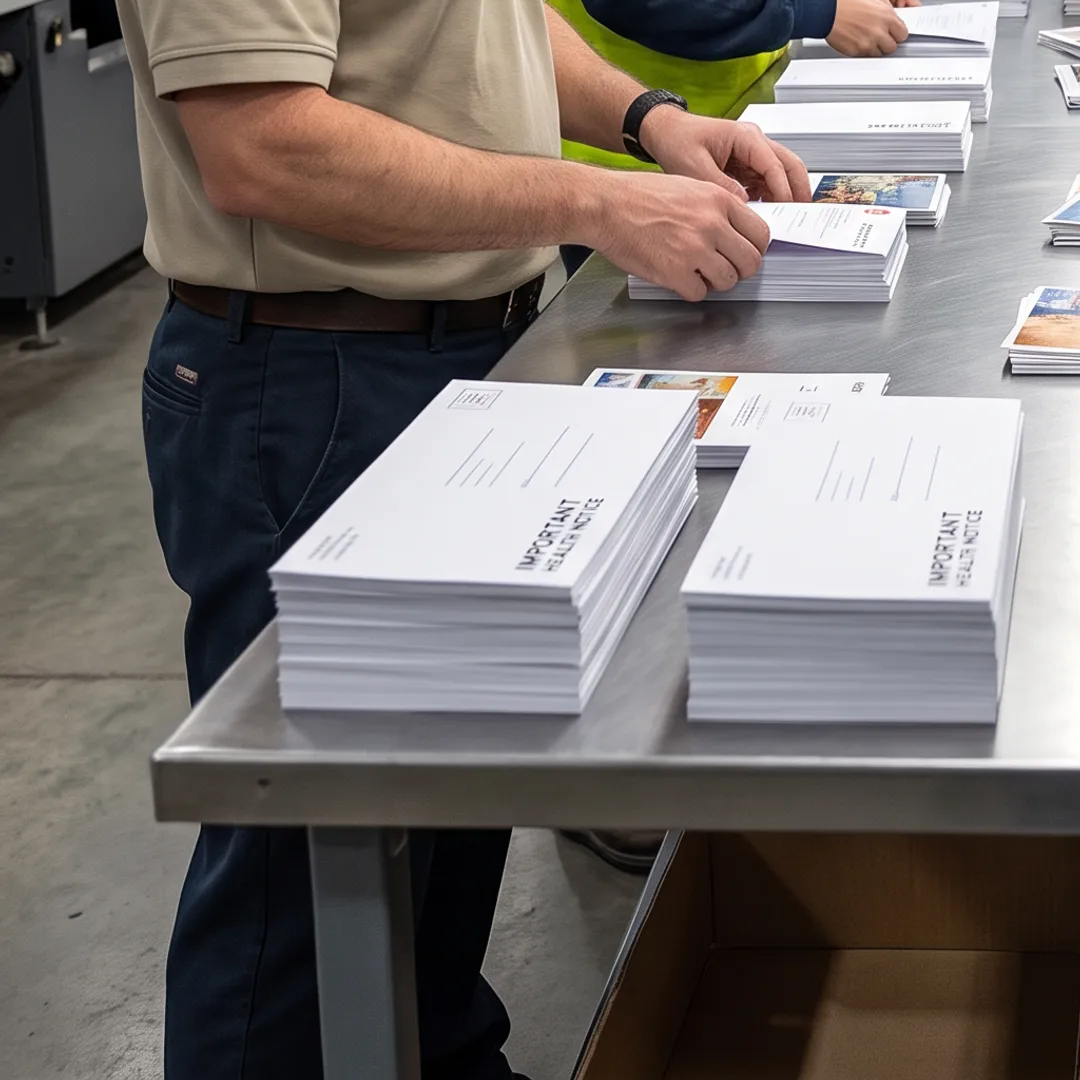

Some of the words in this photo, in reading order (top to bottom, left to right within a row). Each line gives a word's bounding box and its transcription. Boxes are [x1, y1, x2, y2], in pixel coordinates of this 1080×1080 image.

[515, 499, 581, 570] IMPORTANT
[541, 533, 581, 572] HEALTH
[569, 498, 604, 531] NOTICE
[927, 511, 962, 587] IMPORTANT
[963, 510, 983, 545] NOTICE
[956, 548, 977, 587] HEALTH
